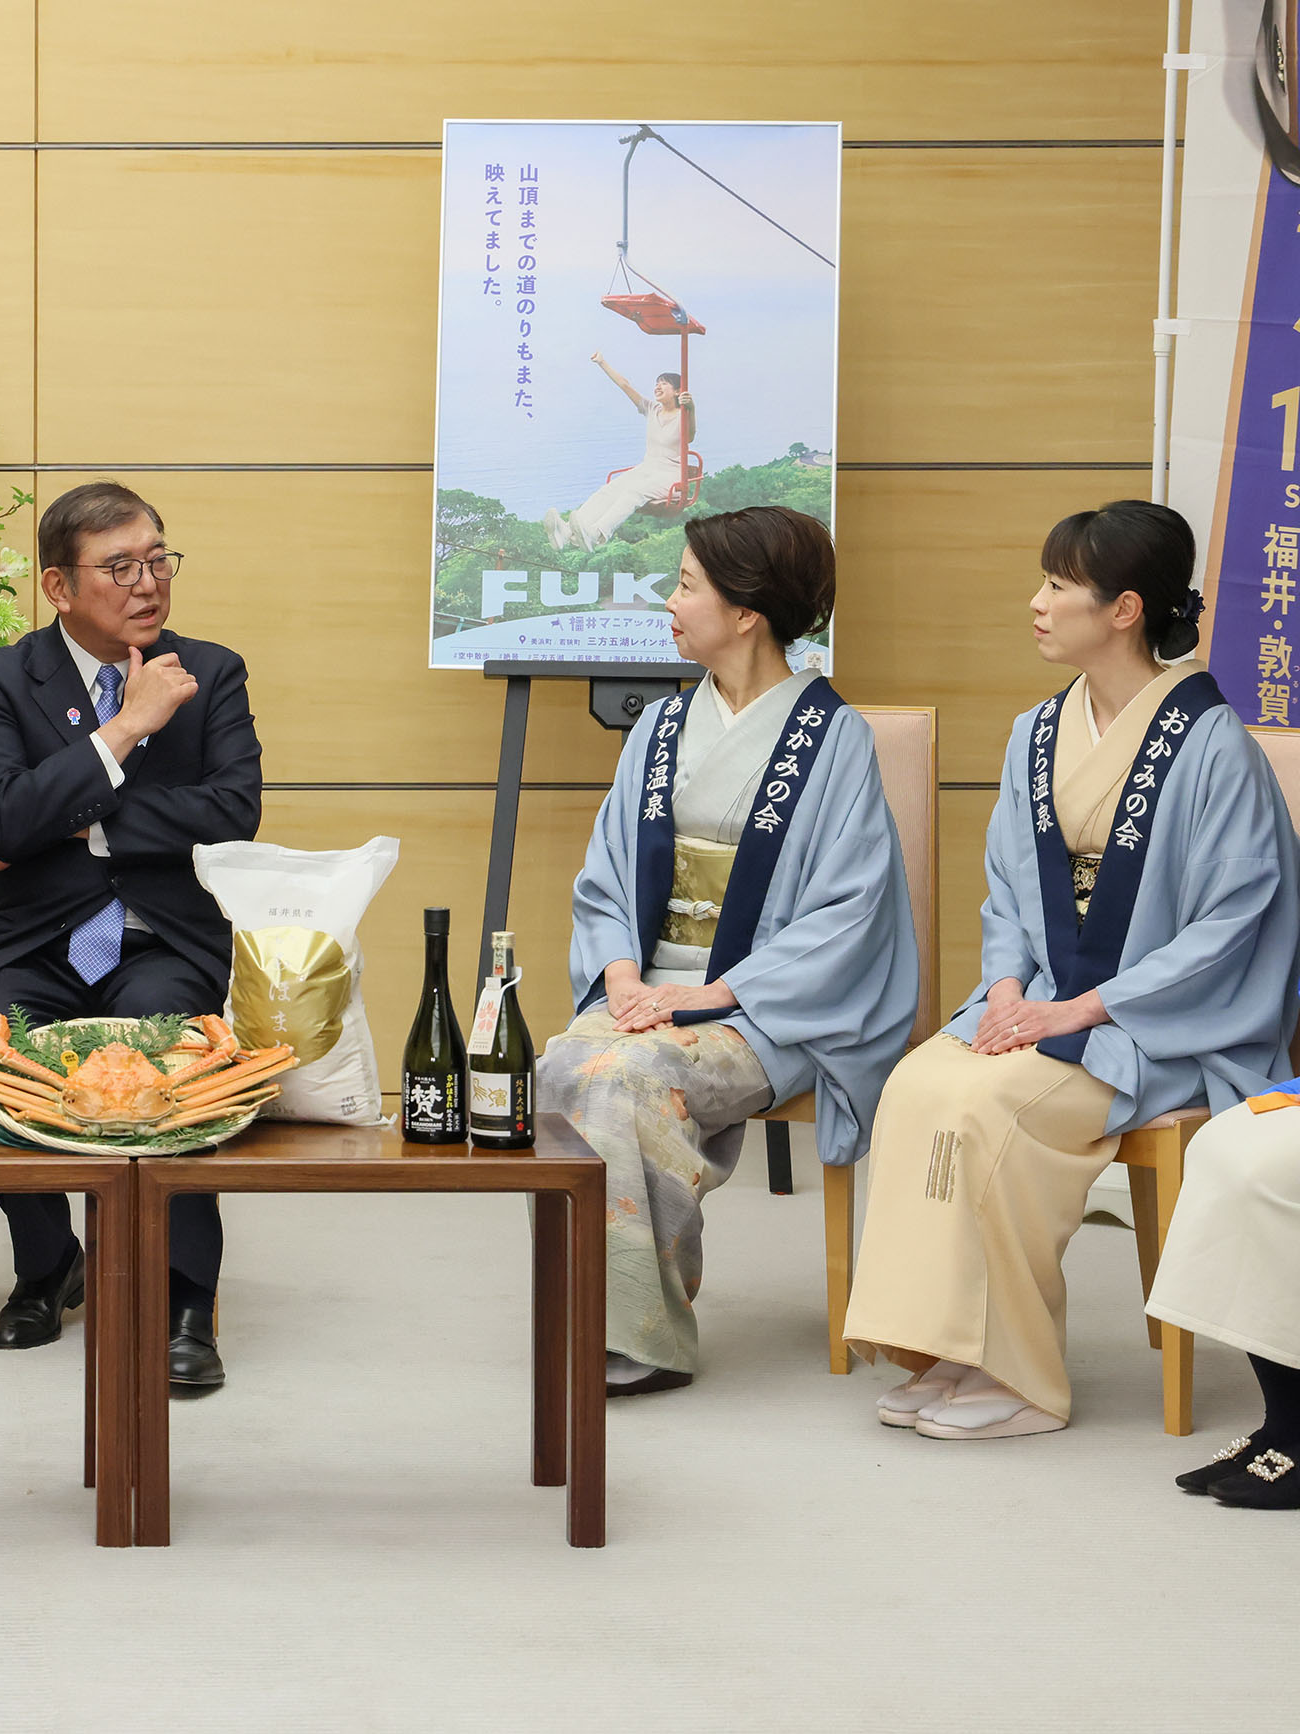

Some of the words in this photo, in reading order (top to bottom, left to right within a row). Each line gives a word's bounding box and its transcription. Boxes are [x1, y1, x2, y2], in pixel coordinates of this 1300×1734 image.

[483, 163, 505, 306] 映えてました。
[515, 163, 539, 418] 山頂までの道のりもまた、
[1256, 524, 1300, 727] 福井・敦賀
[642, 696, 683, 821] あわら温泉
[754, 705, 826, 834] おかみの会
[1032, 698, 1057, 833] あわら温泉
[1115, 706, 1189, 850] おかみの会
